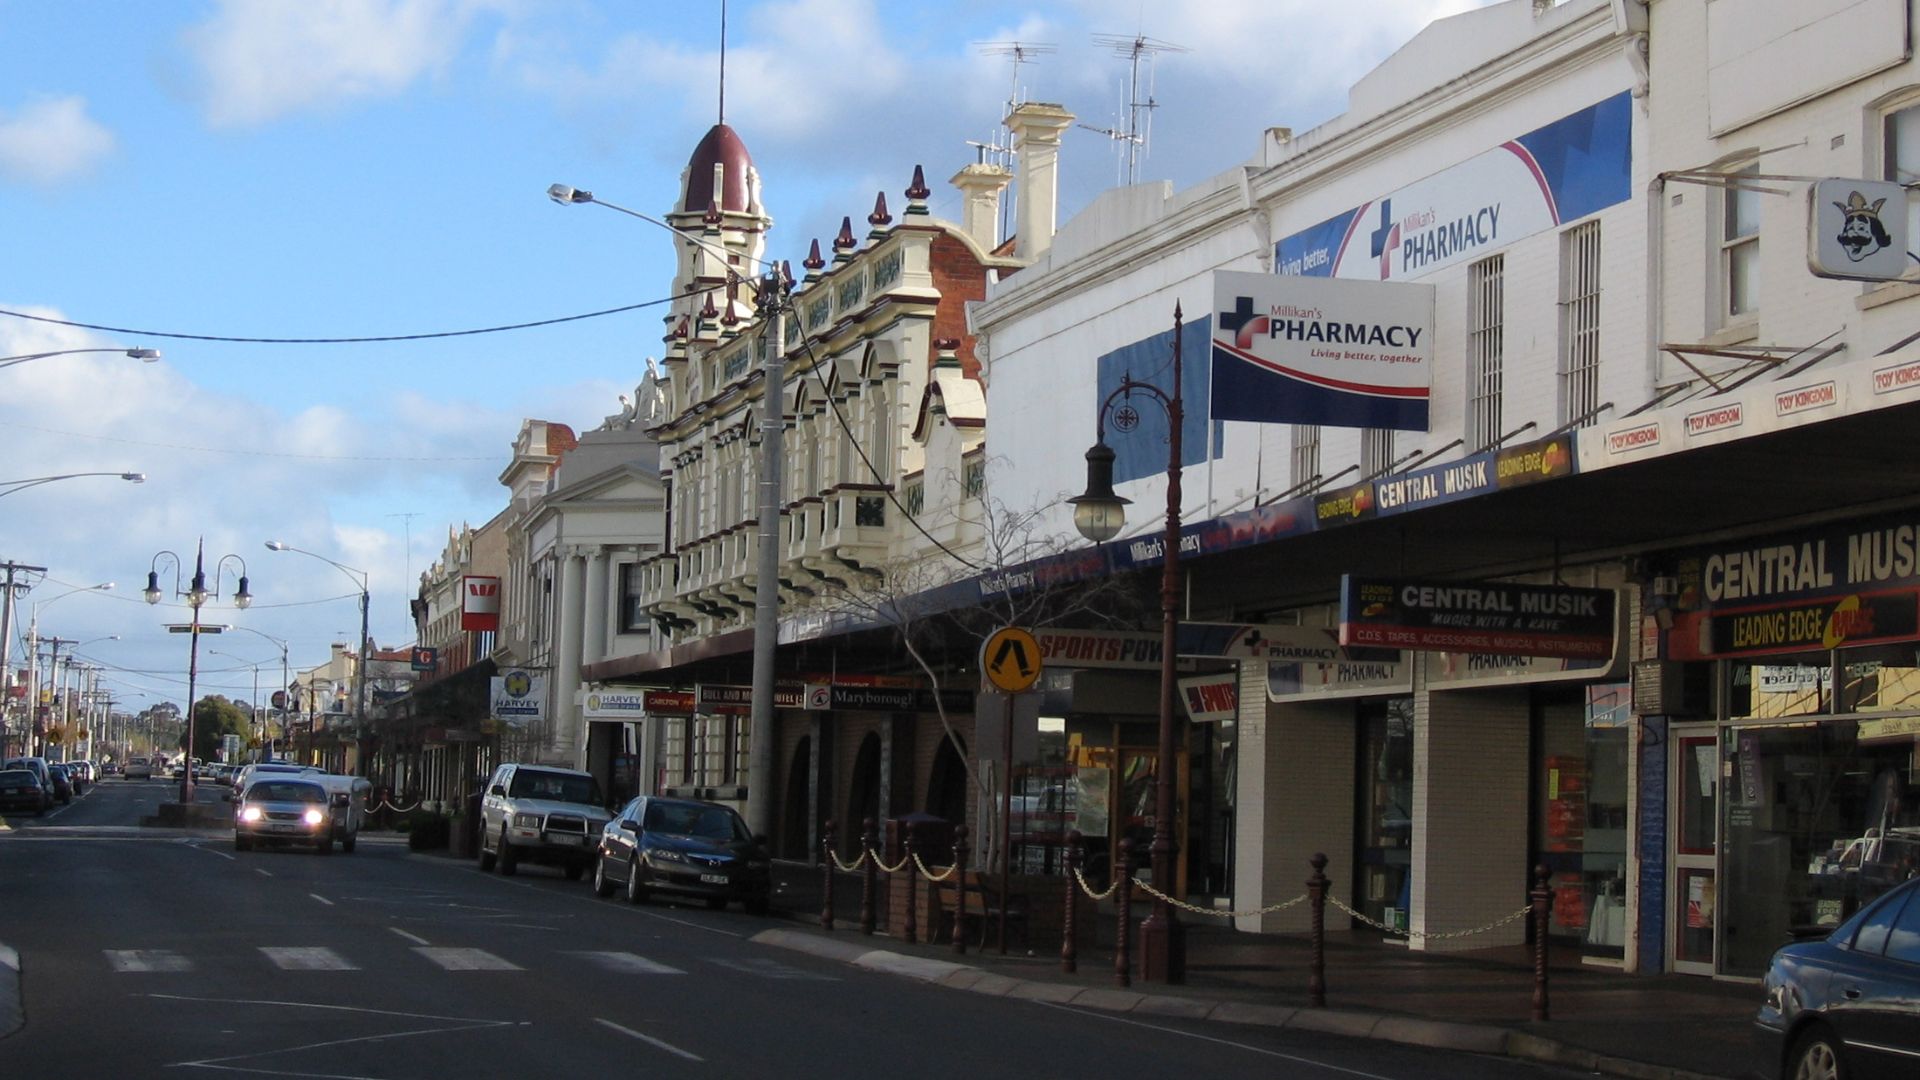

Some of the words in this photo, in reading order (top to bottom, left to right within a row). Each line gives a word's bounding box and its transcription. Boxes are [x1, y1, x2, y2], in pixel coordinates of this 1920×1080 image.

[1403, 202, 1500, 273] PHARMACY
[1271, 304, 1323, 320] Millikan's
[1270, 318, 1422, 348] PHARMACY
[1310, 348, 1342, 361] Living
[1344, 350, 1377, 362] better,
[1380, 353, 1422, 364] together
[1876, 371, 1893, 388] TOY
[1778, 395, 1794, 411] TOY
[1795, 386, 1834, 408] KINGDOM
[1690, 414, 1705, 431] TOY
[1705, 408, 1740, 429] KINGDOM
[1611, 432, 1625, 449] TOY
[1625, 426, 1658, 446] KINGDOM
[1498, 456, 1524, 478] LEADING
[1379, 480, 1438, 509] CENTRAL
[1445, 461, 1488, 494] MUSIK
[1705, 539, 1833, 601] CENTRAL
[1402, 585, 1514, 612] CENTRAL
[1520, 592, 1596, 617] MUSIK
[1733, 611, 1785, 648] LEADING
[1789, 607, 1822, 642] EDGE
[1270, 647, 1338, 659] PHARMACY
[496, 699, 539, 707] HARVEY
[602, 695, 641, 704] HARVEY
